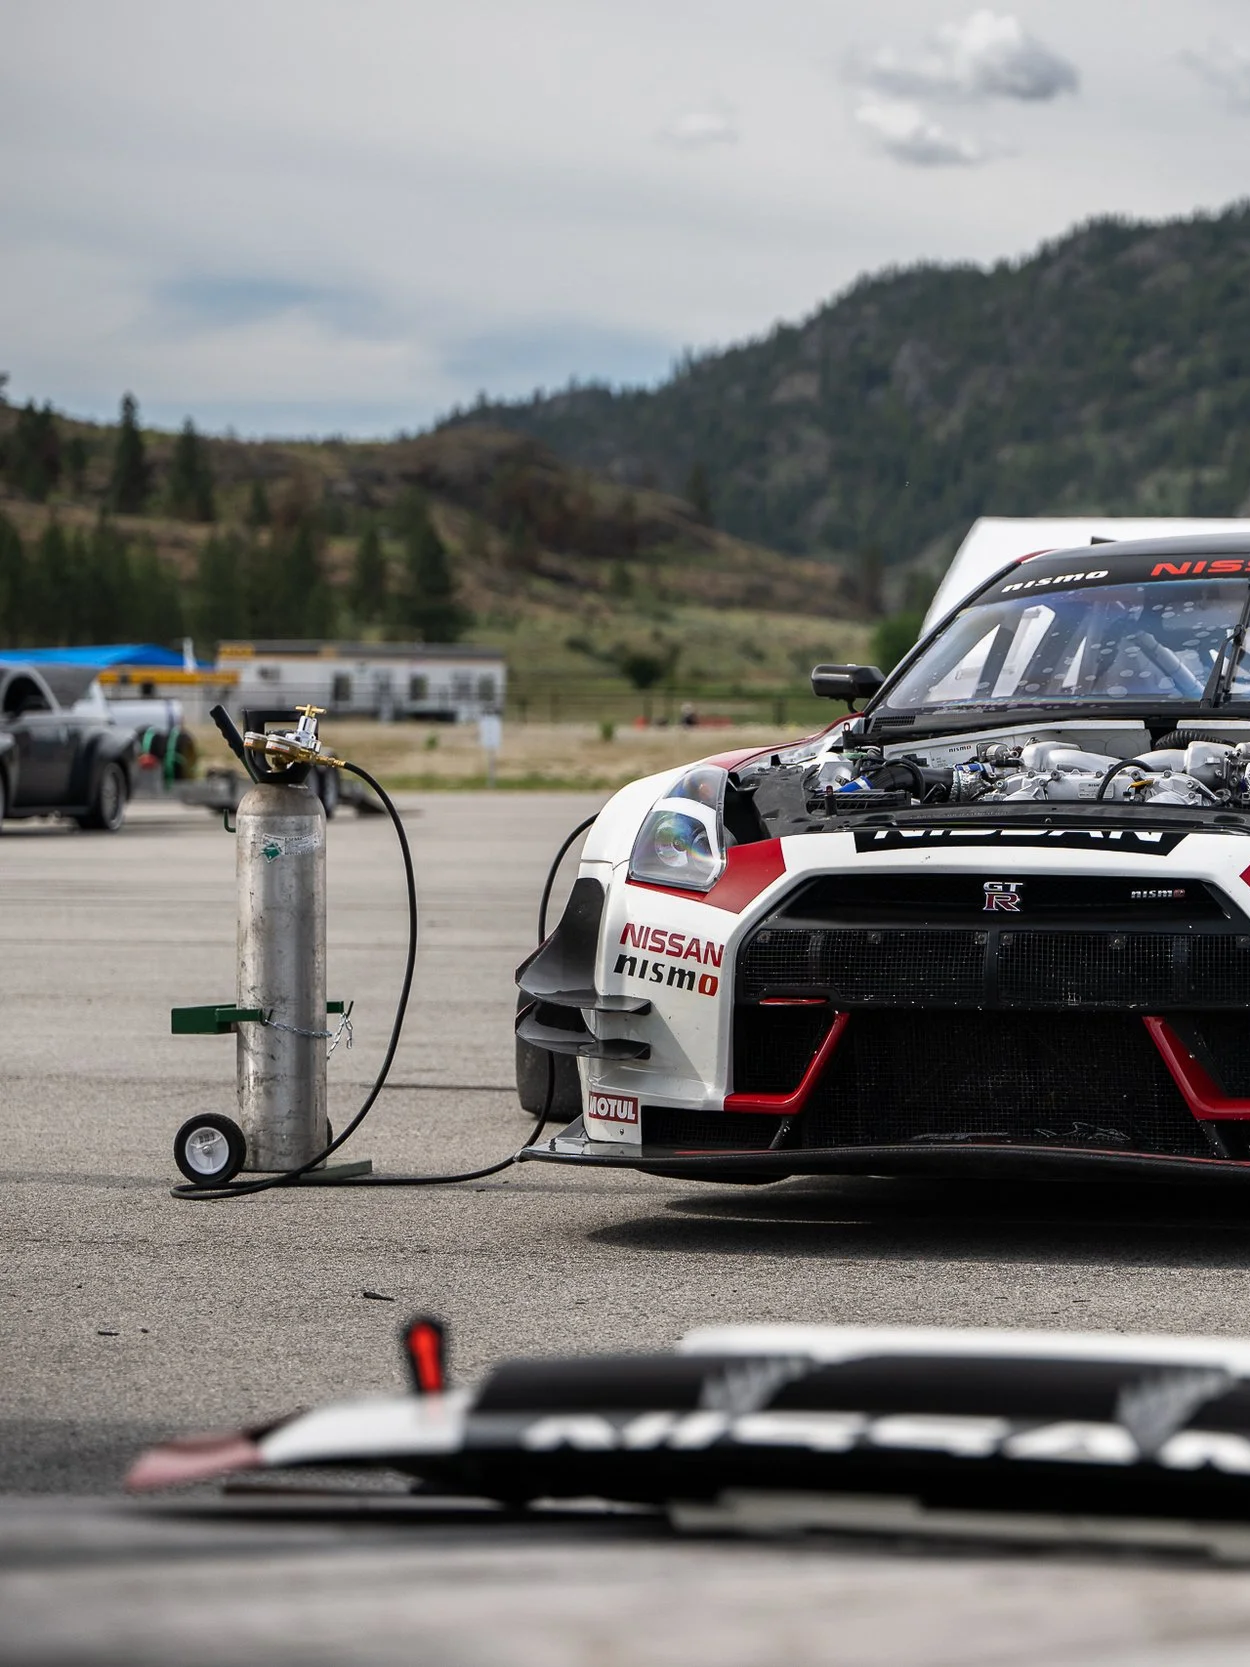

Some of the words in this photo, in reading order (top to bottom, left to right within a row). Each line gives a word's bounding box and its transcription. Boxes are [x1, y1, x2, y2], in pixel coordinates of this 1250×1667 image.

[1001, 570, 1109, 593] nismo
[983, 881, 1023, 892] GT
[1131, 889, 1186, 899] nismo
[983, 892, 1020, 912] R
[620, 922, 724, 968] NISSAN
[614, 954, 719, 997] nismo
[589, 1096, 636, 1120] MOTUL
